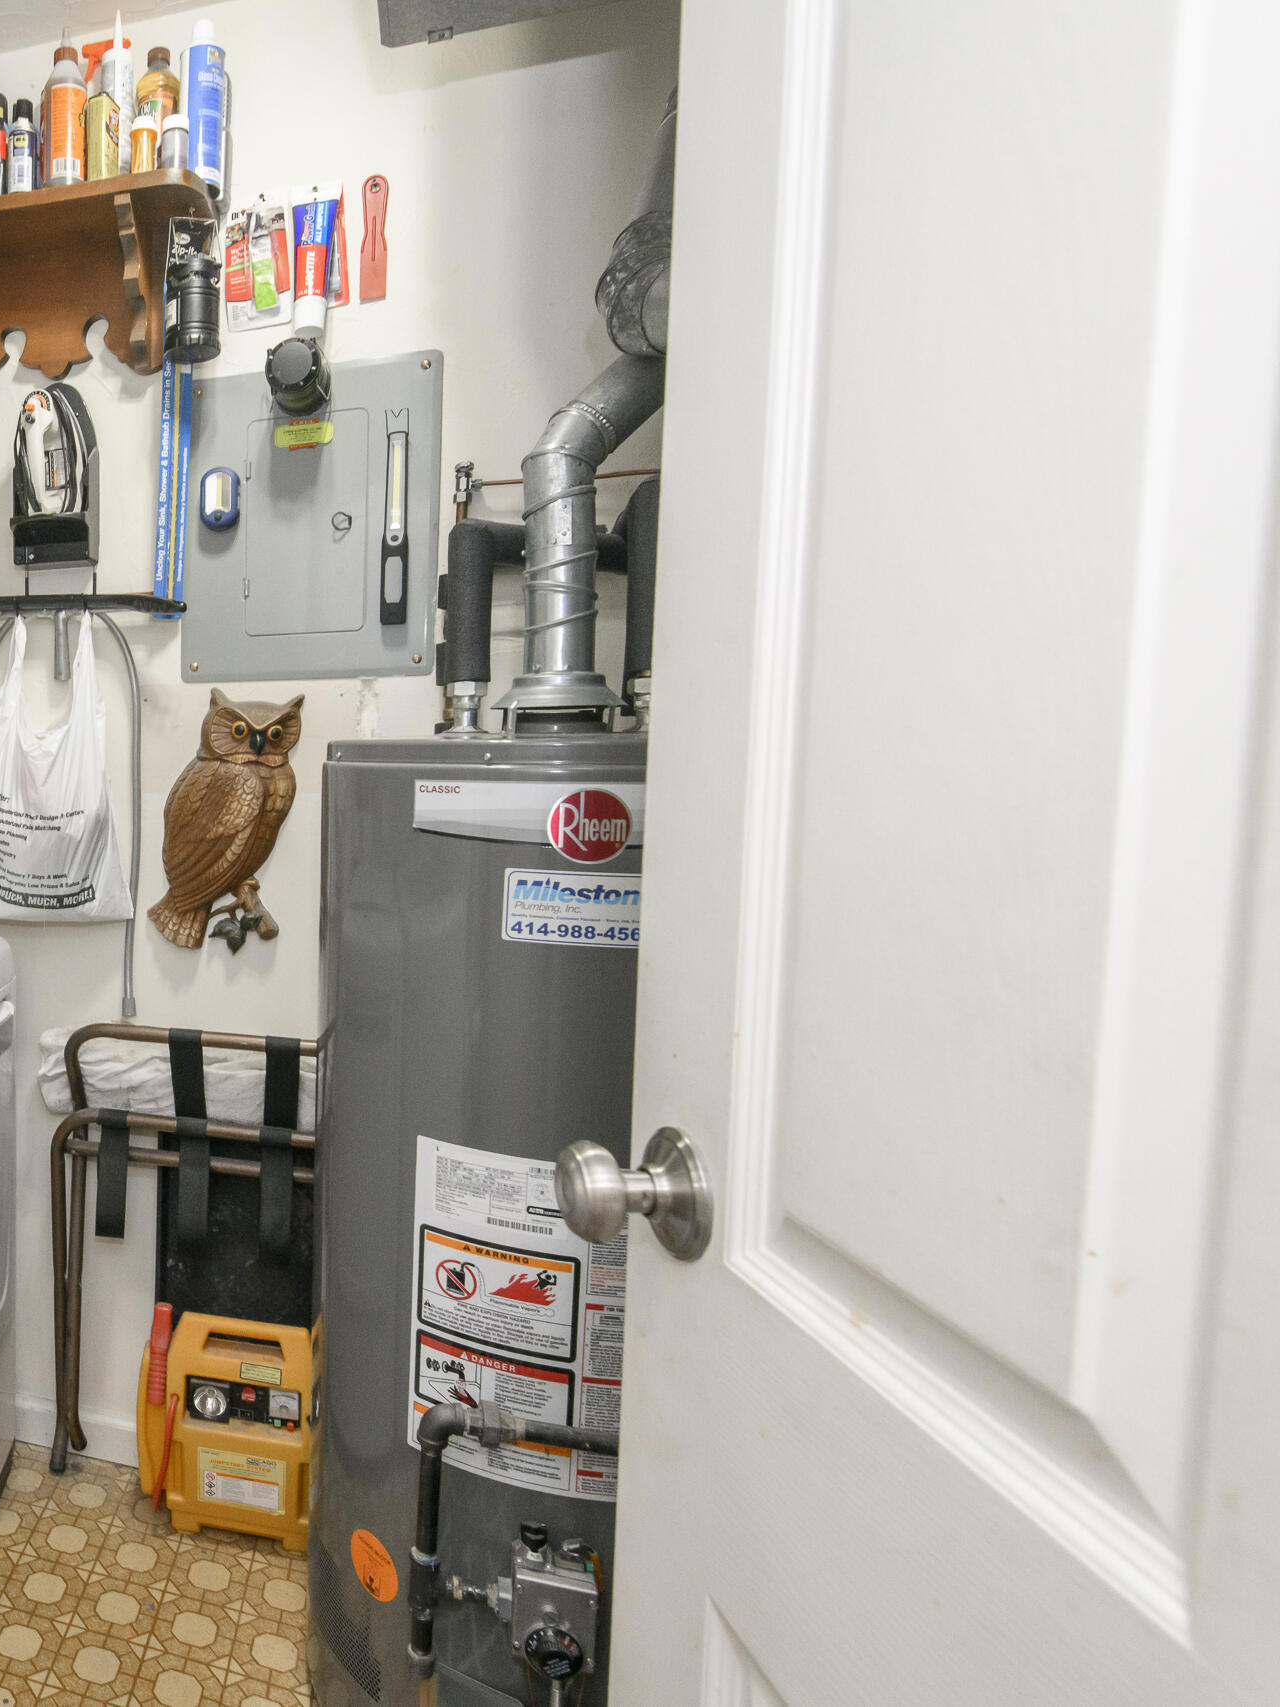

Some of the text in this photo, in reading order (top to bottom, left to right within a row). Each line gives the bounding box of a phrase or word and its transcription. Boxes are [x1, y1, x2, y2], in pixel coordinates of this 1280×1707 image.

[305, 251, 315, 286] LOCTITE
[164, 380, 171, 388] in
[162, 422, 170, 457] Bathtub
[160, 468, 168, 502] Shower
[158, 505, 167, 526] Sink,
[156, 550, 166, 580] Unclog
[419, 784, 461, 794] CLASSIC
[558, 792, 627, 851] Rheem
[0, 889, 25, 904] MUCH,
[28, 896, 60, 908] MUCH,
[63, 888, 93, 906] MORE!
[514, 900, 583, 914] Plumbing, Inc.
[473, 1246, 530, 1265] WARNING
[471, 1354, 516, 1373] DANGER
